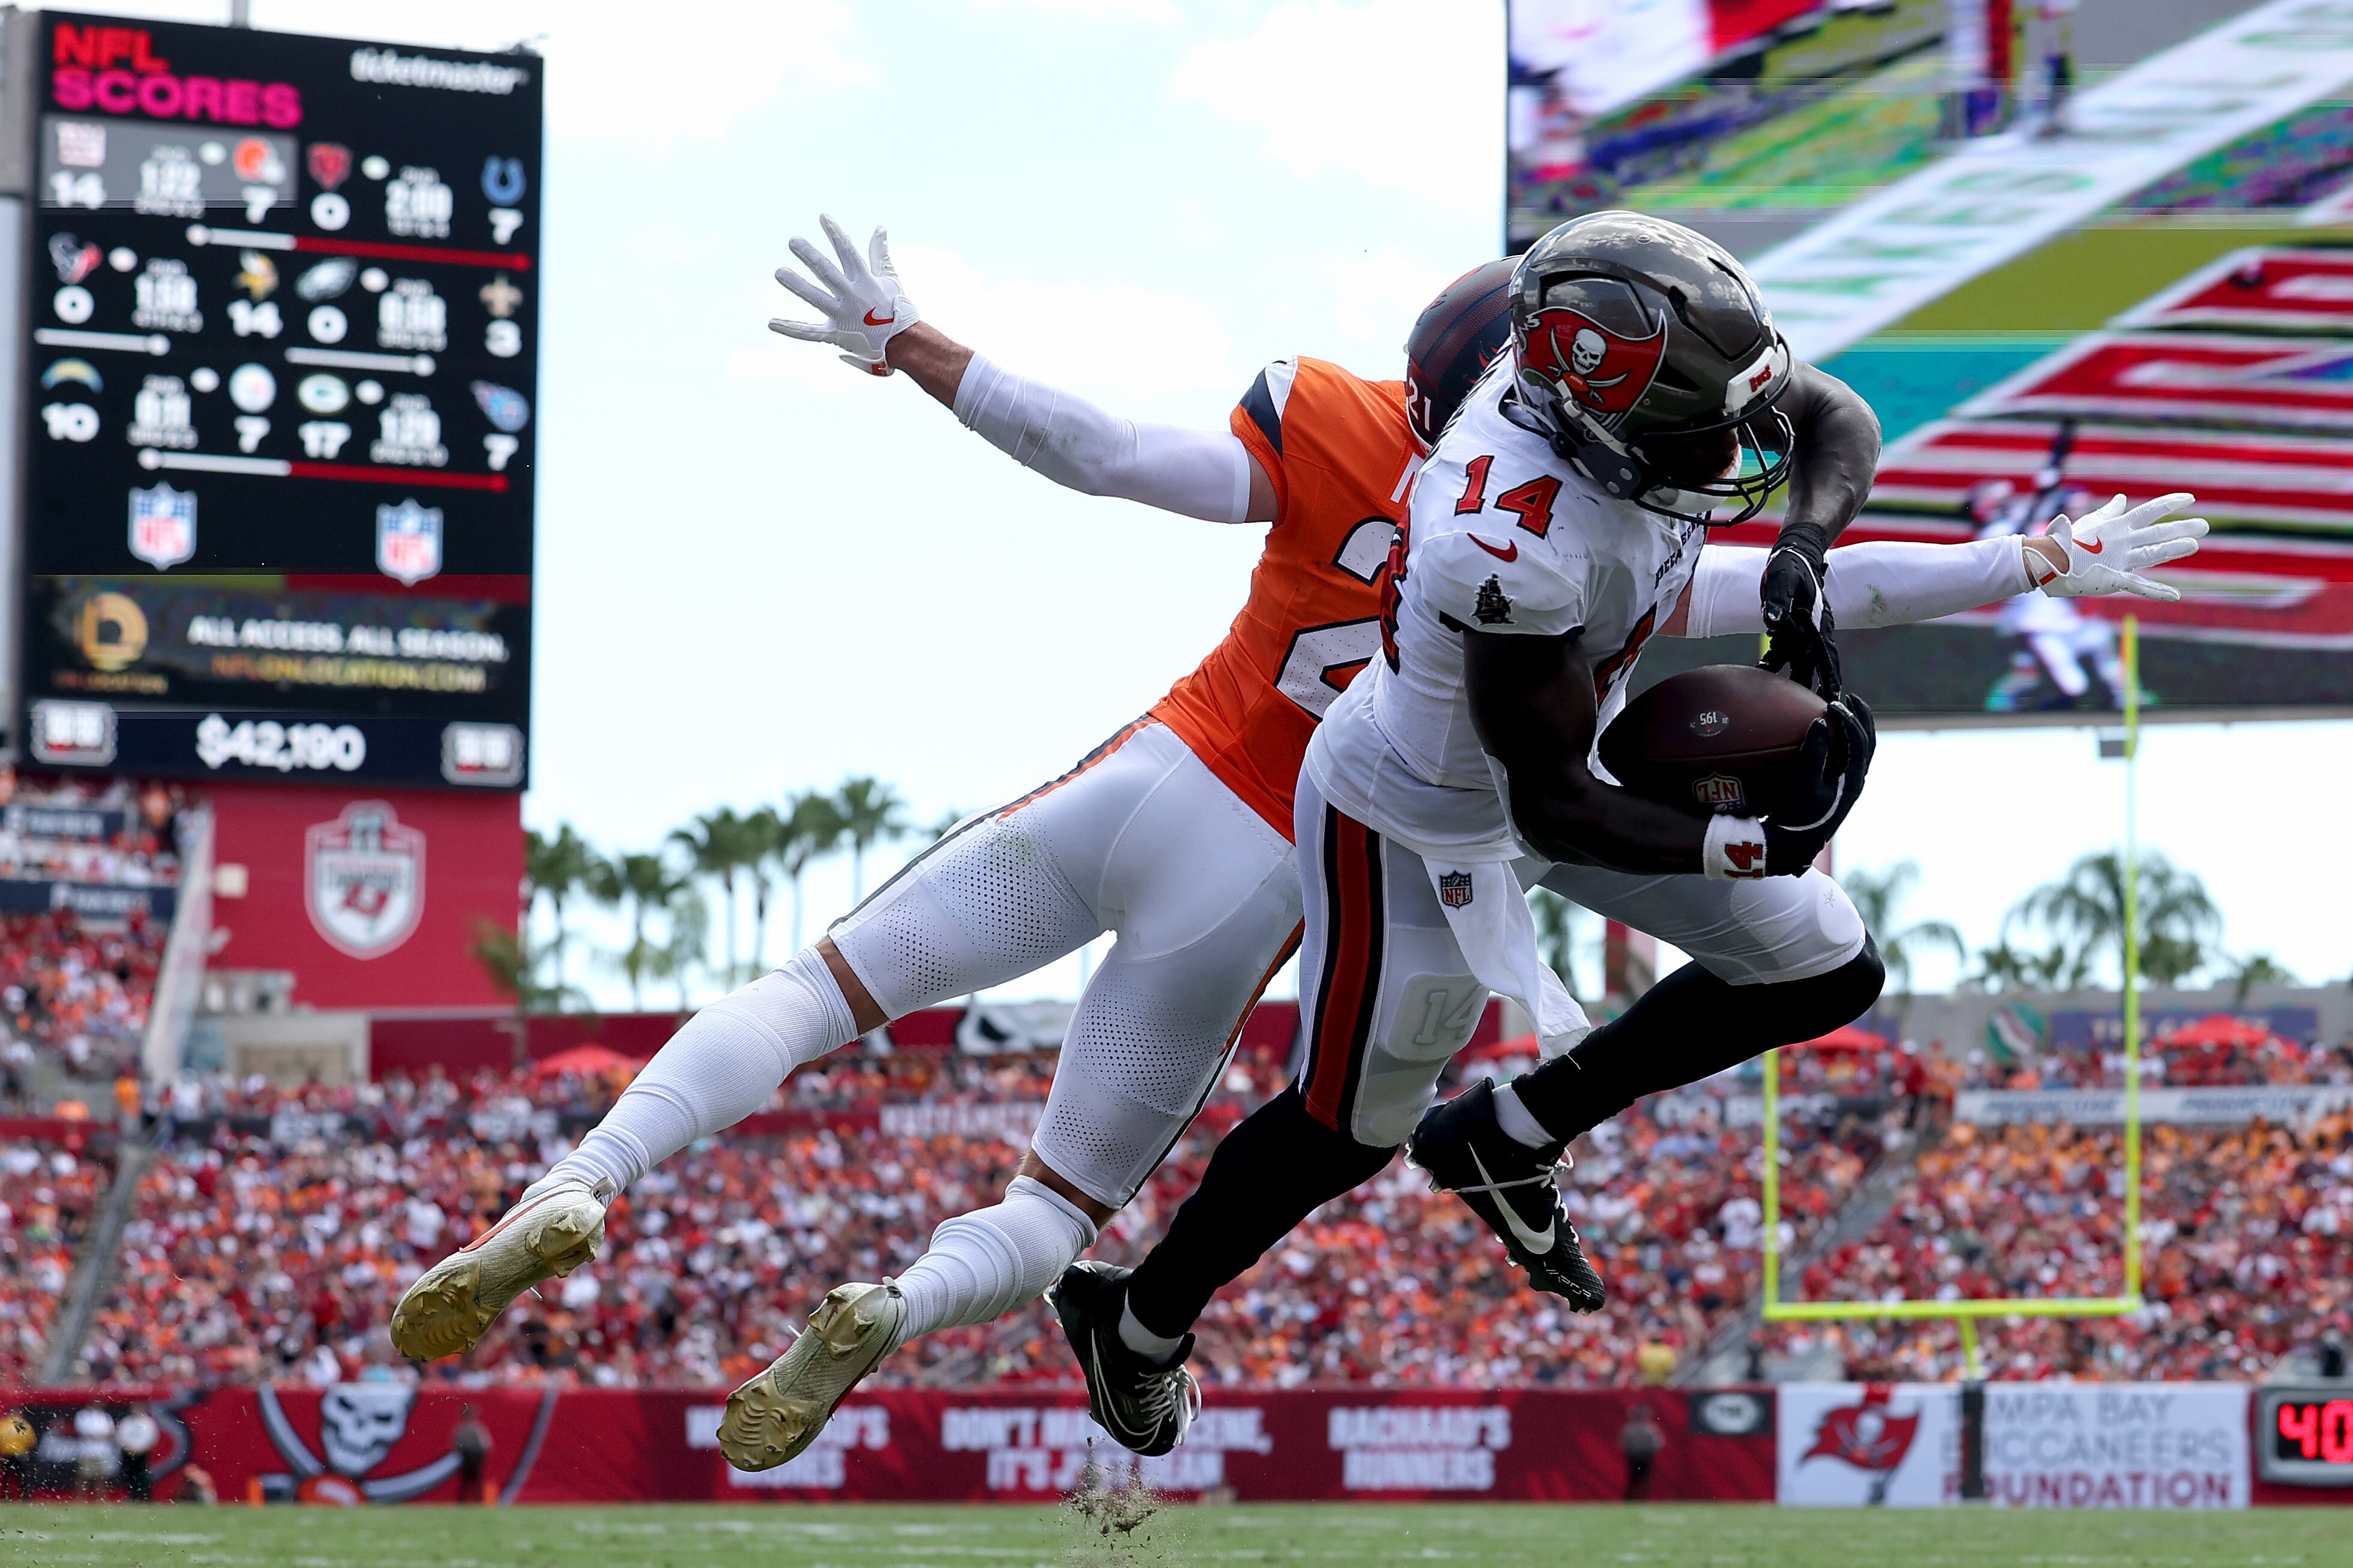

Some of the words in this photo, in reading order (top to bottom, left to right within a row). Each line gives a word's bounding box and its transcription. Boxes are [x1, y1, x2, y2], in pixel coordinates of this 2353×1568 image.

[53, 22, 170, 71] NFL
[350, 47, 526, 95] ticketmaster
[52, 67, 302, 128] SCORES
[49, 169, 107, 209] 14
[241, 185, 277, 224] 7
[310, 191, 350, 231] 0
[487, 207, 524, 245] 7
[53, 285, 95, 324] 0
[226, 299, 284, 338] 14
[307, 305, 348, 344] 0
[484, 319, 522, 358] 3
[41, 402, 100, 443] 10
[1408, 377, 1431, 432] 21
[233, 415, 271, 454] 7
[298, 421, 352, 460] 17
[483, 433, 519, 471] 7
[1454, 455, 1563, 540] 14
[187, 615, 238, 646] ALL
[346, 625, 396, 656] ALL
[196, 712, 367, 772] $42,190
[1698, 779, 1739, 802] NFL
[1723, 841, 1764, 879] 14
[1443, 886, 1471, 905] NFL
[1946, 1392, 2081, 1425] TMPA
[2098, 1392, 2177, 1425] BAY
[942, 1407, 1035, 1450] DON'T
[1941, 1429, 2231, 1467] BCCANEERS
[2279, 1399, 2353, 1464] 40
[987, 1449, 1050, 1491] IT'S
[1342, 1450, 1495, 1491] RUNNERS
